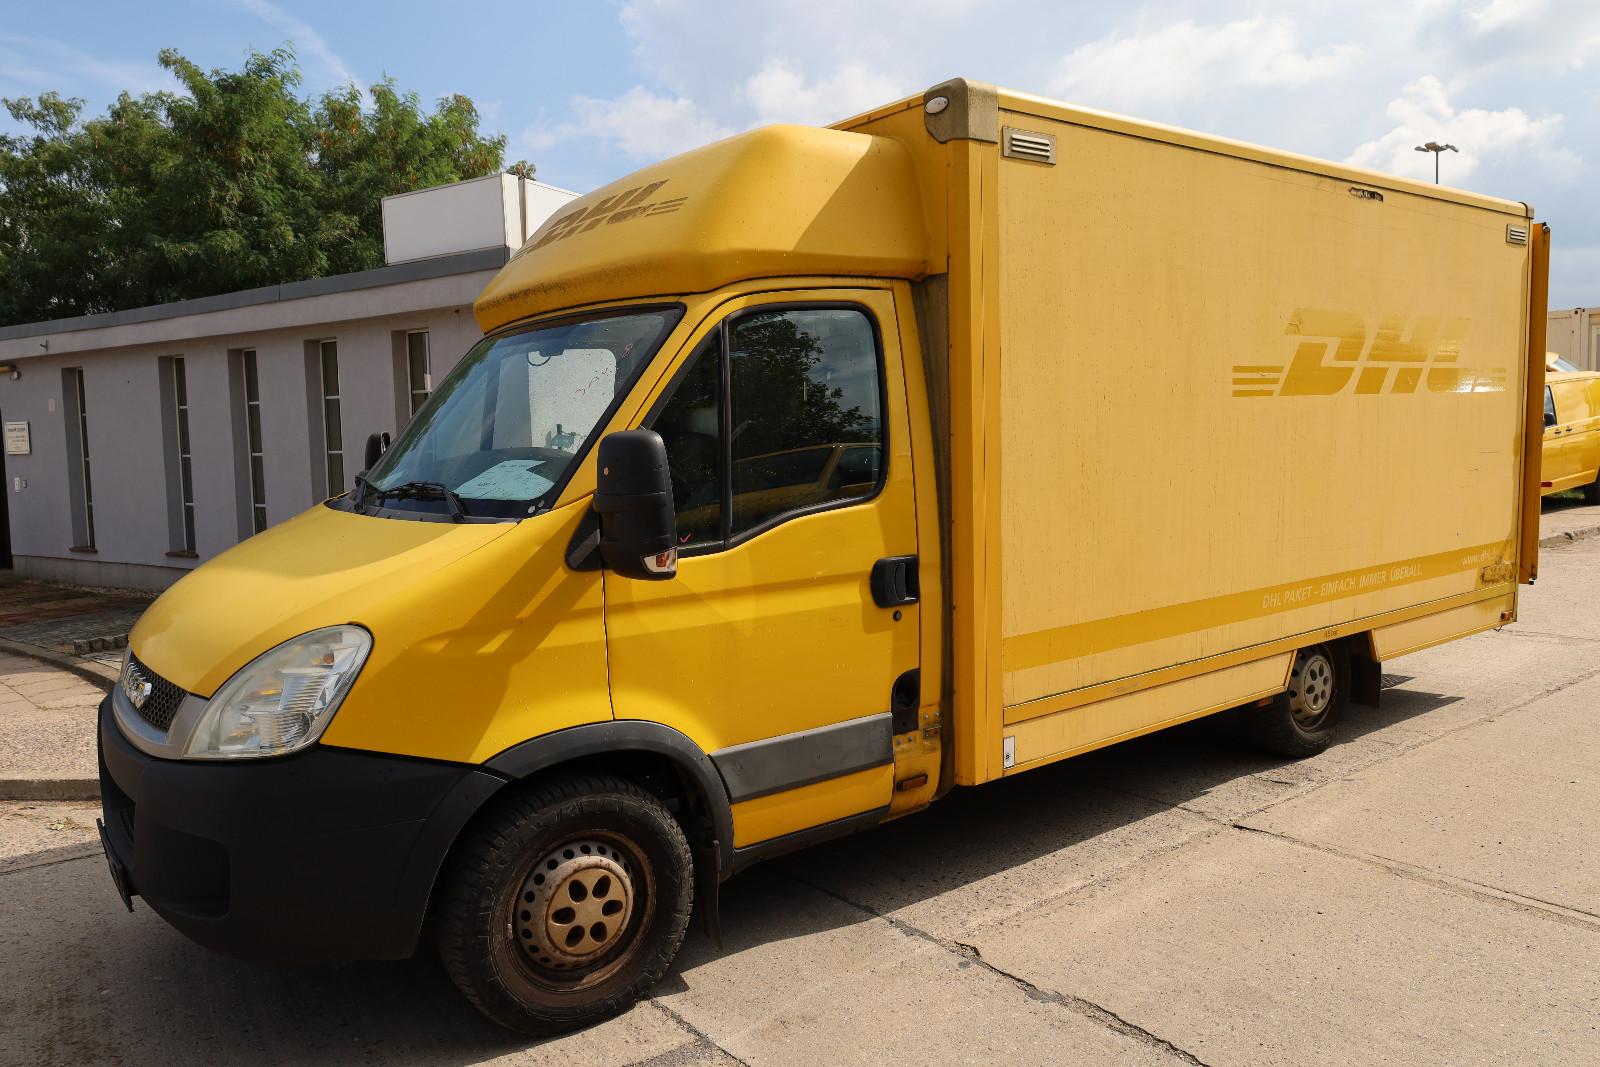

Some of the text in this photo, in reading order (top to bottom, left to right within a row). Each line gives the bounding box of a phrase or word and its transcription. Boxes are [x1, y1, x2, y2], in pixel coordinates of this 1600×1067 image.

[1278, 307, 1475, 396] DHL
[1262, 592, 1281, 609] DHL
[1284, 585, 1313, 602] PAKET
[1321, 577, 1356, 597] EINFACH
[1360, 570, 1386, 587] IMMER
